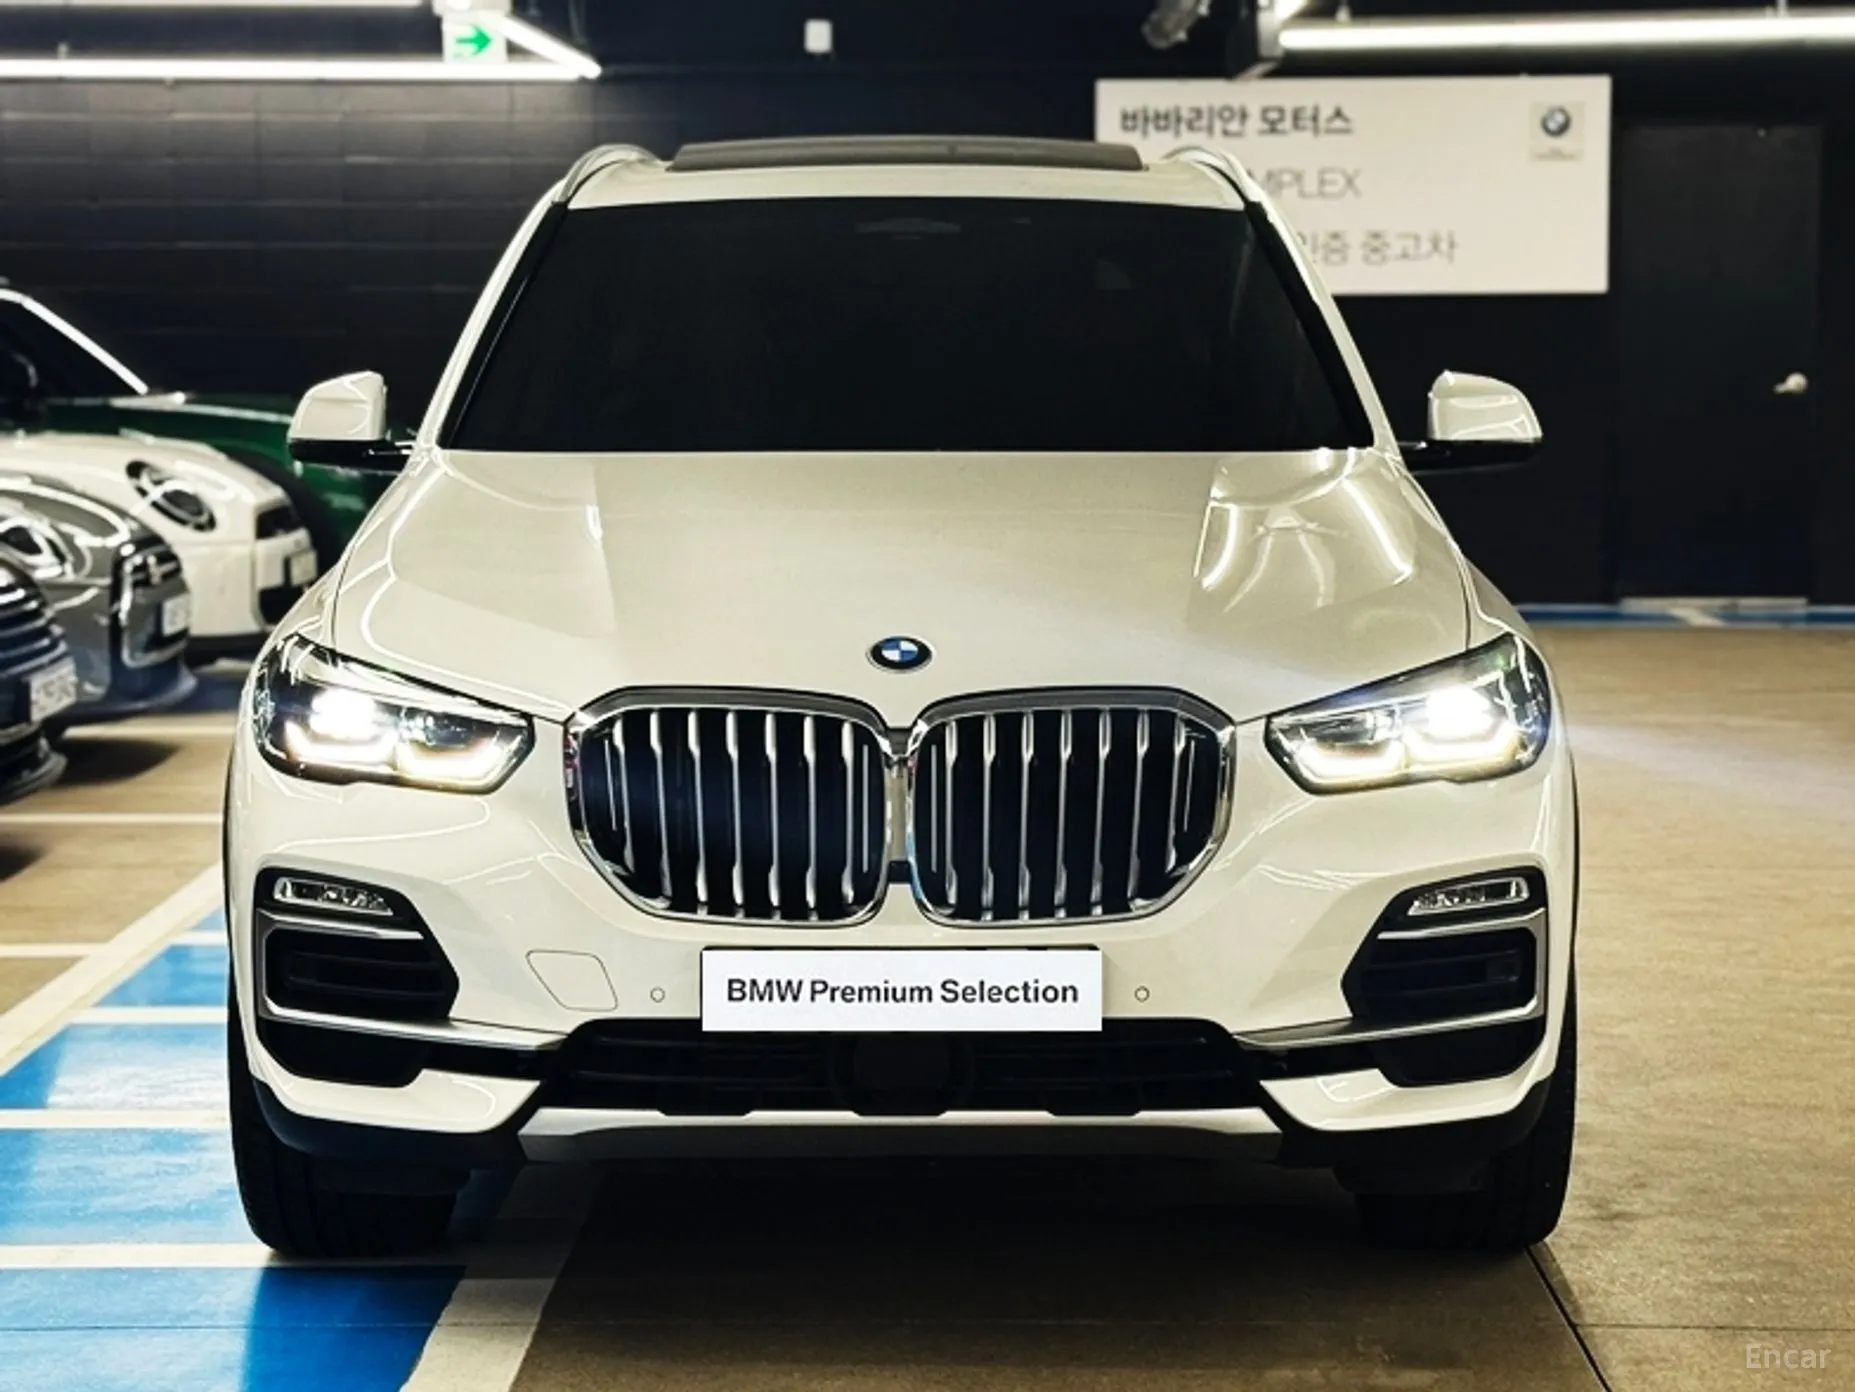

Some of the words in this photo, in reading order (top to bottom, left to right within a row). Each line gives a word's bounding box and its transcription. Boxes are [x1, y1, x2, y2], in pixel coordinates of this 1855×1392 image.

[1120, 104, 1250, 139] 바바리안
[1257, 104, 1354, 139] 모터스
[1360, 228, 1460, 267] 중고차
[726, 977, 803, 1003] BMW
[809, 977, 933, 1004] Premium
[940, 977, 1079, 1004] Selection
